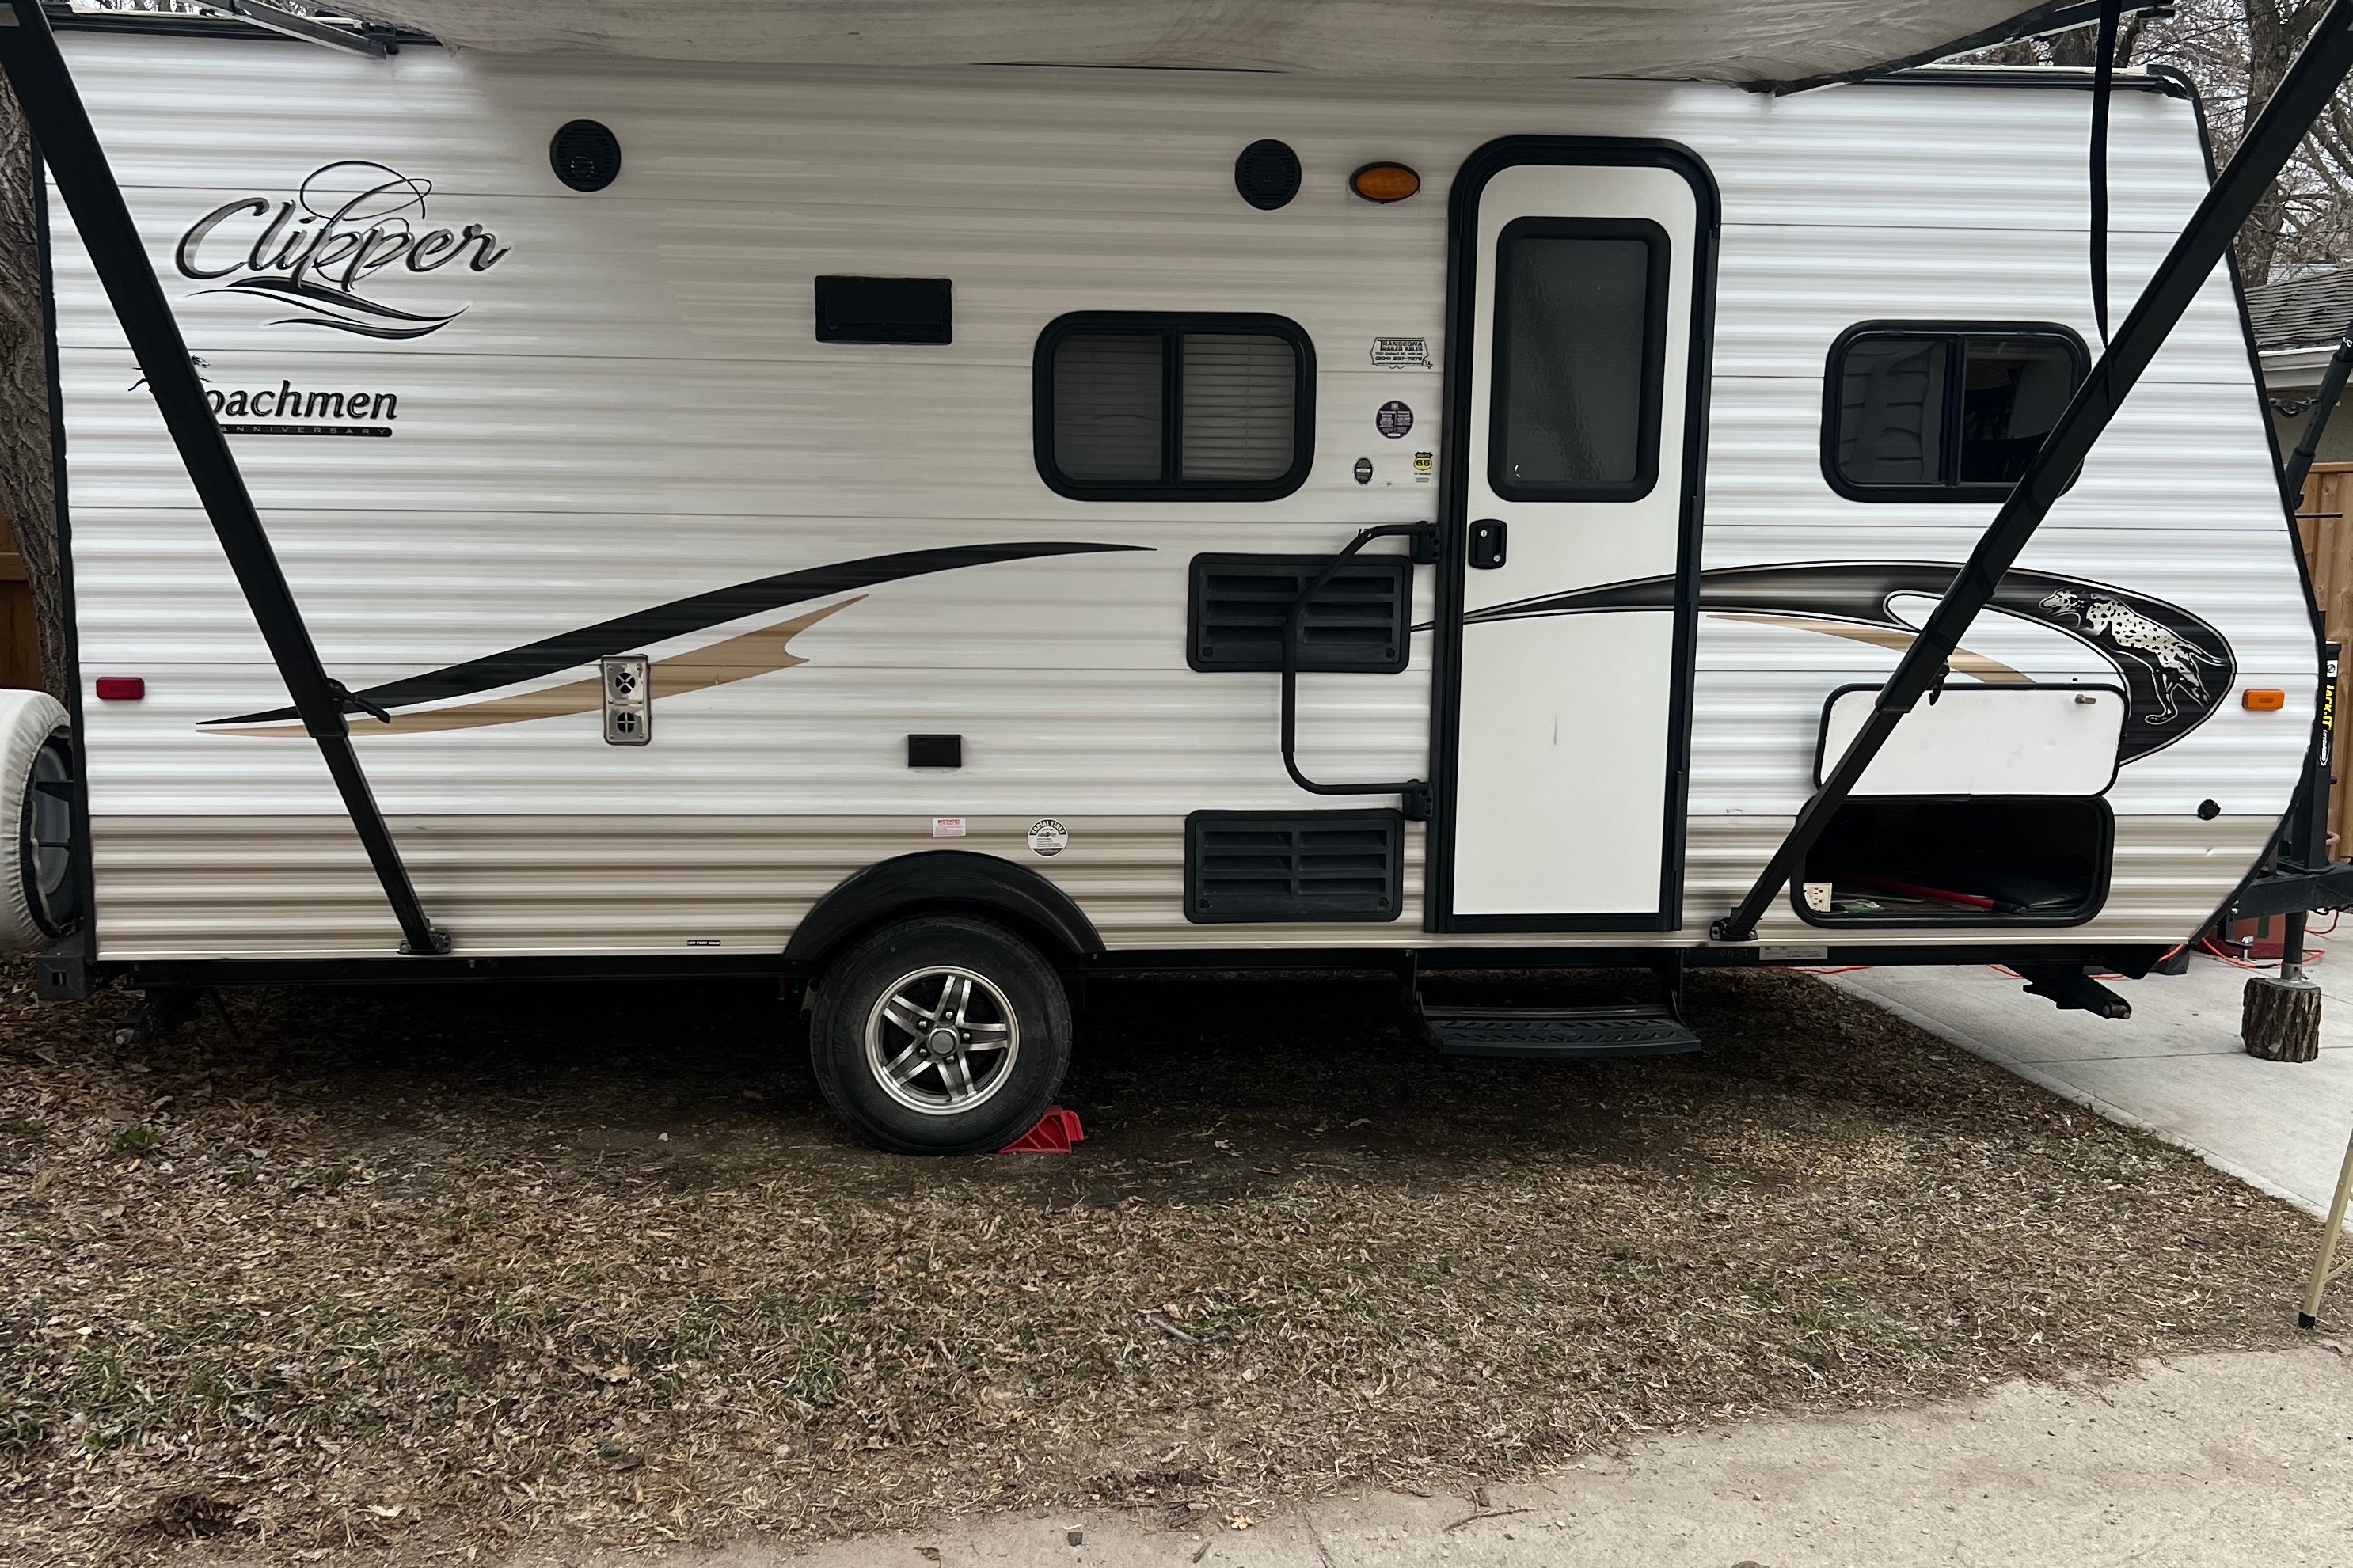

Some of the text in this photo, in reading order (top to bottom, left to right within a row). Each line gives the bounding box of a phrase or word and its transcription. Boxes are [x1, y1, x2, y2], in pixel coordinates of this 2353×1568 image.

[175, 161, 511, 292] Clipper
[204, 380, 397, 420] oachmen
[220, 426, 386, 435] ANNIVERSARY
[1051, 820, 1065, 834] TIRES
